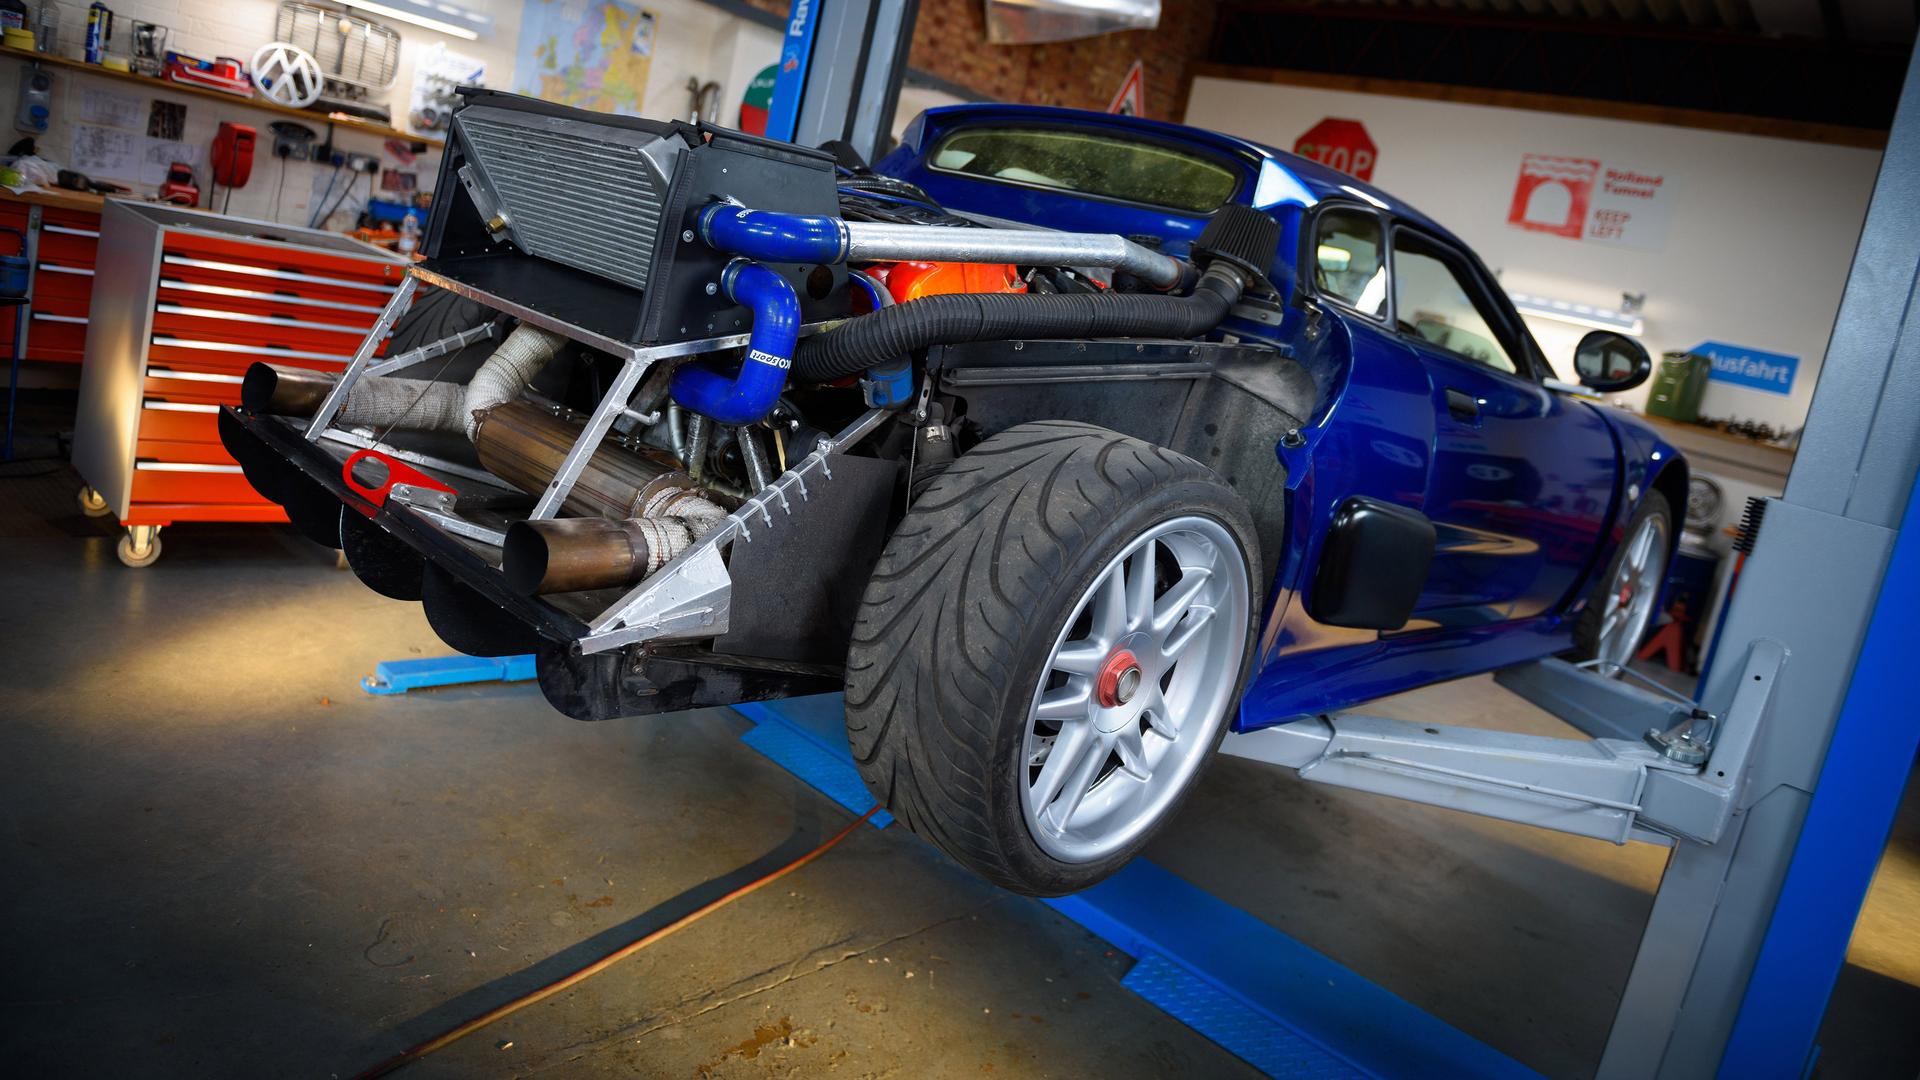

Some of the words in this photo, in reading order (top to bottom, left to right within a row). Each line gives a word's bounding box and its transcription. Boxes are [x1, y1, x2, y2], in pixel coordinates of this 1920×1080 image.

[1605, 169, 1664, 187] Holland
[1603, 182, 1655, 199] Tunnel
[1594, 209, 1631, 223] KEEP
[1589, 225, 1624, 239] LEFT
[751, 351, 779, 365] sport
